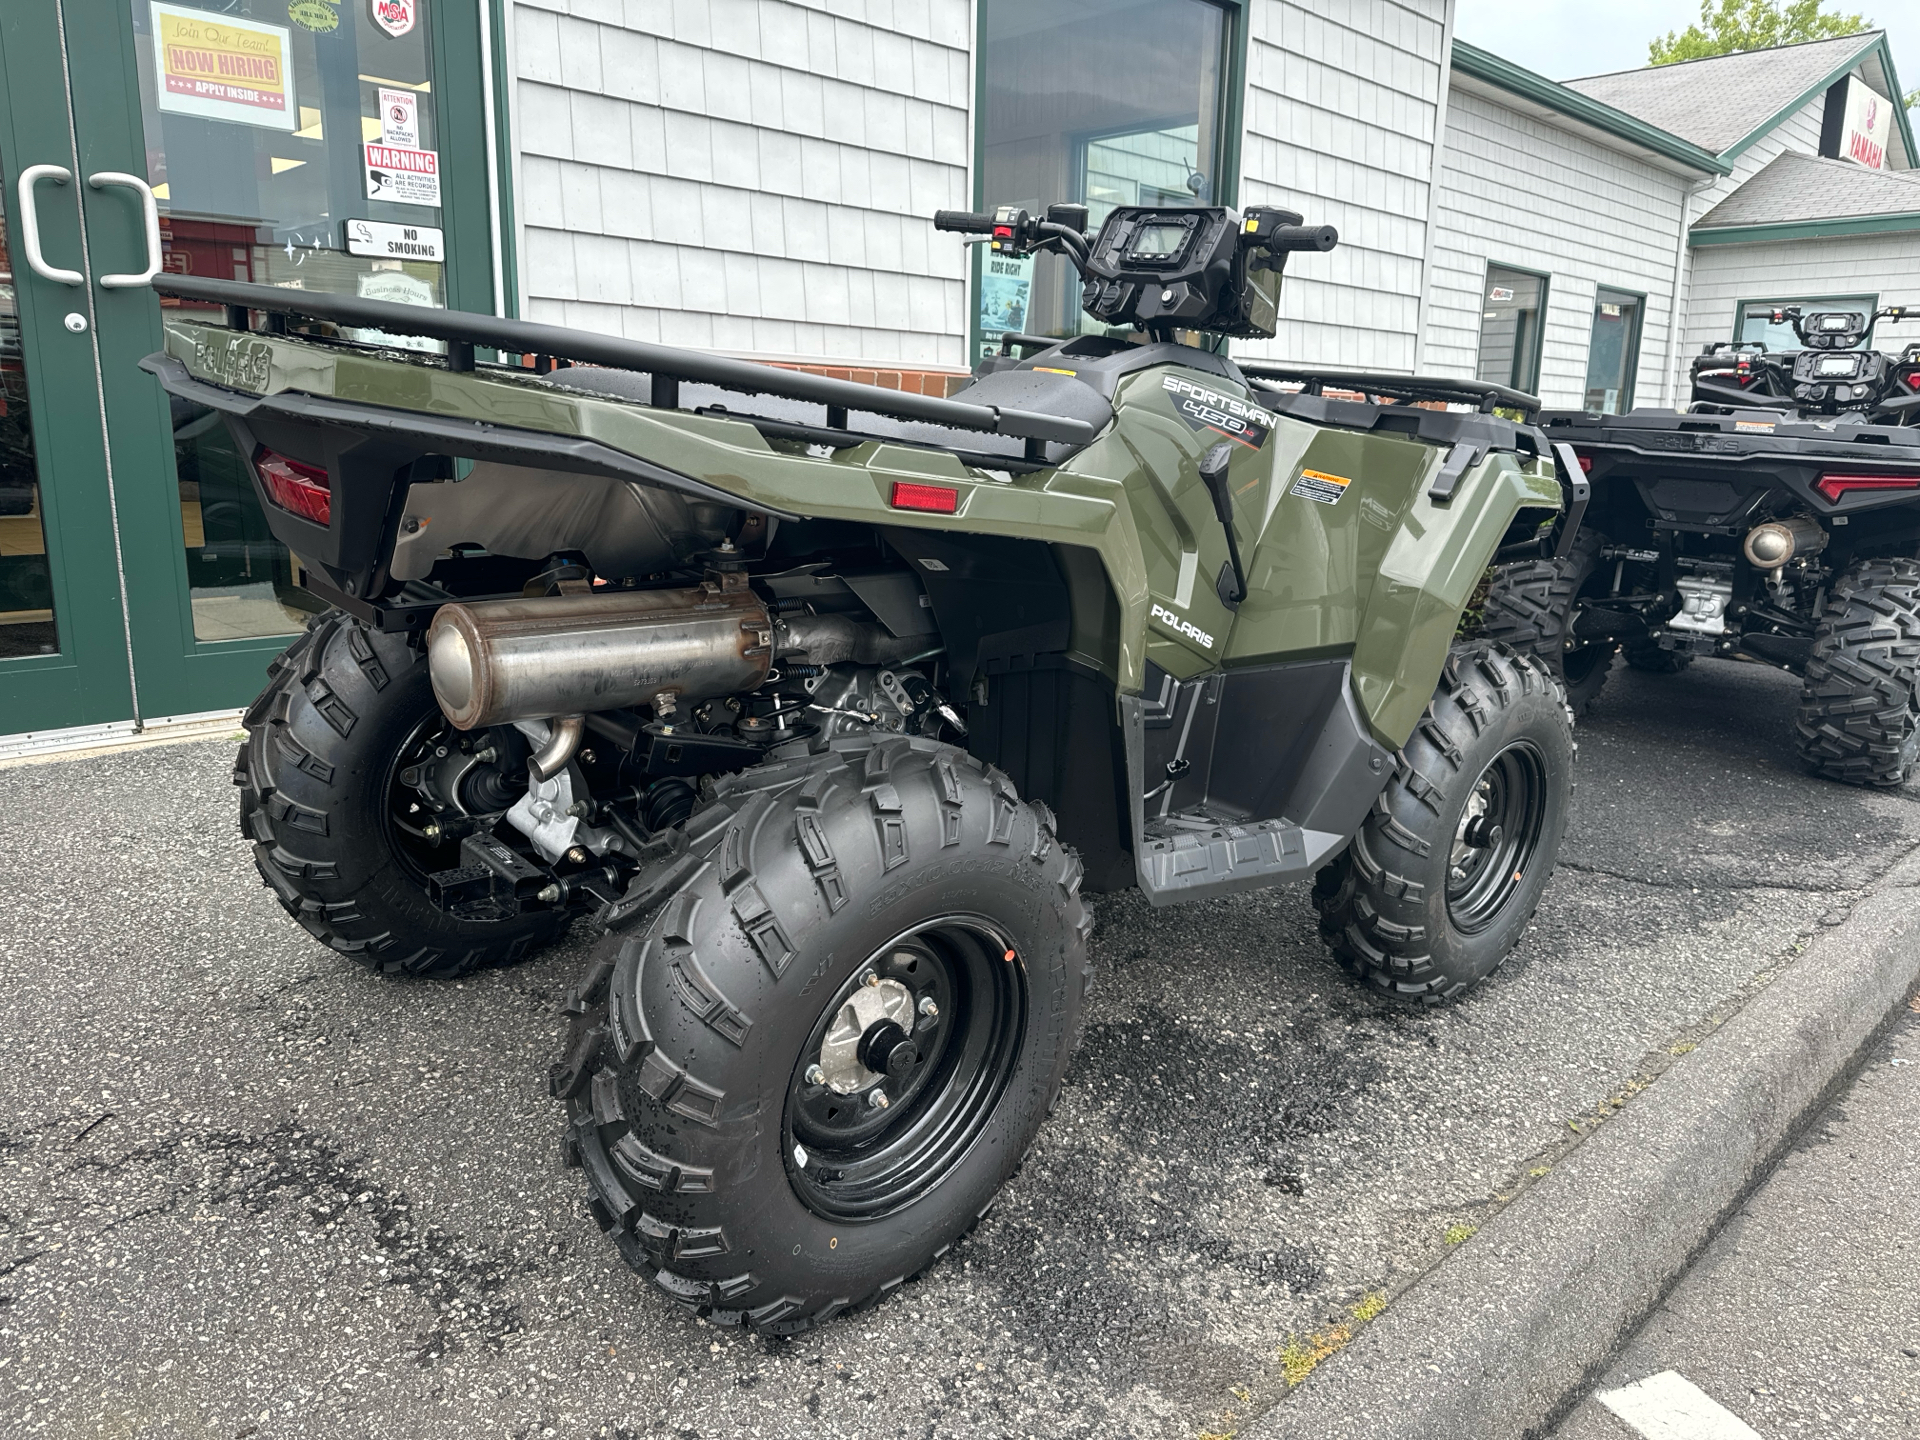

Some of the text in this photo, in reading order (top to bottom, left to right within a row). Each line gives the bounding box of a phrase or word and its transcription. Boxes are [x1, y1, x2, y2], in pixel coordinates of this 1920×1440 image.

[378, 1, 409, 22] MSA
[172, 22, 270, 52] Join Our Team!
[172, 48, 276, 80] NOW HIRING
[196, 81, 260, 102] APPLY INSIDE
[384, 94, 414, 105] ATTENTION
[386, 129, 414, 138] BACKPACKS
[1850, 130, 1883, 169] YAMAHA
[369, 147, 434, 172] WARNING
[407, 174, 436, 183] ACTIVITIES
[408, 181, 437, 190] RECORDED
[404, 228, 417, 241] NO
[387, 241, 435, 257] SMOKING
[990, 260, 1021, 276] RIDE RIGHT
[365, 286, 428, 301] Business Hours
[1162, 376, 1278, 429] SPORTSMAN
[1183, 400, 1247, 434] 450
[1653, 436, 1740, 451] POLARIS
[1150, 603, 1214, 649] POLARIS
